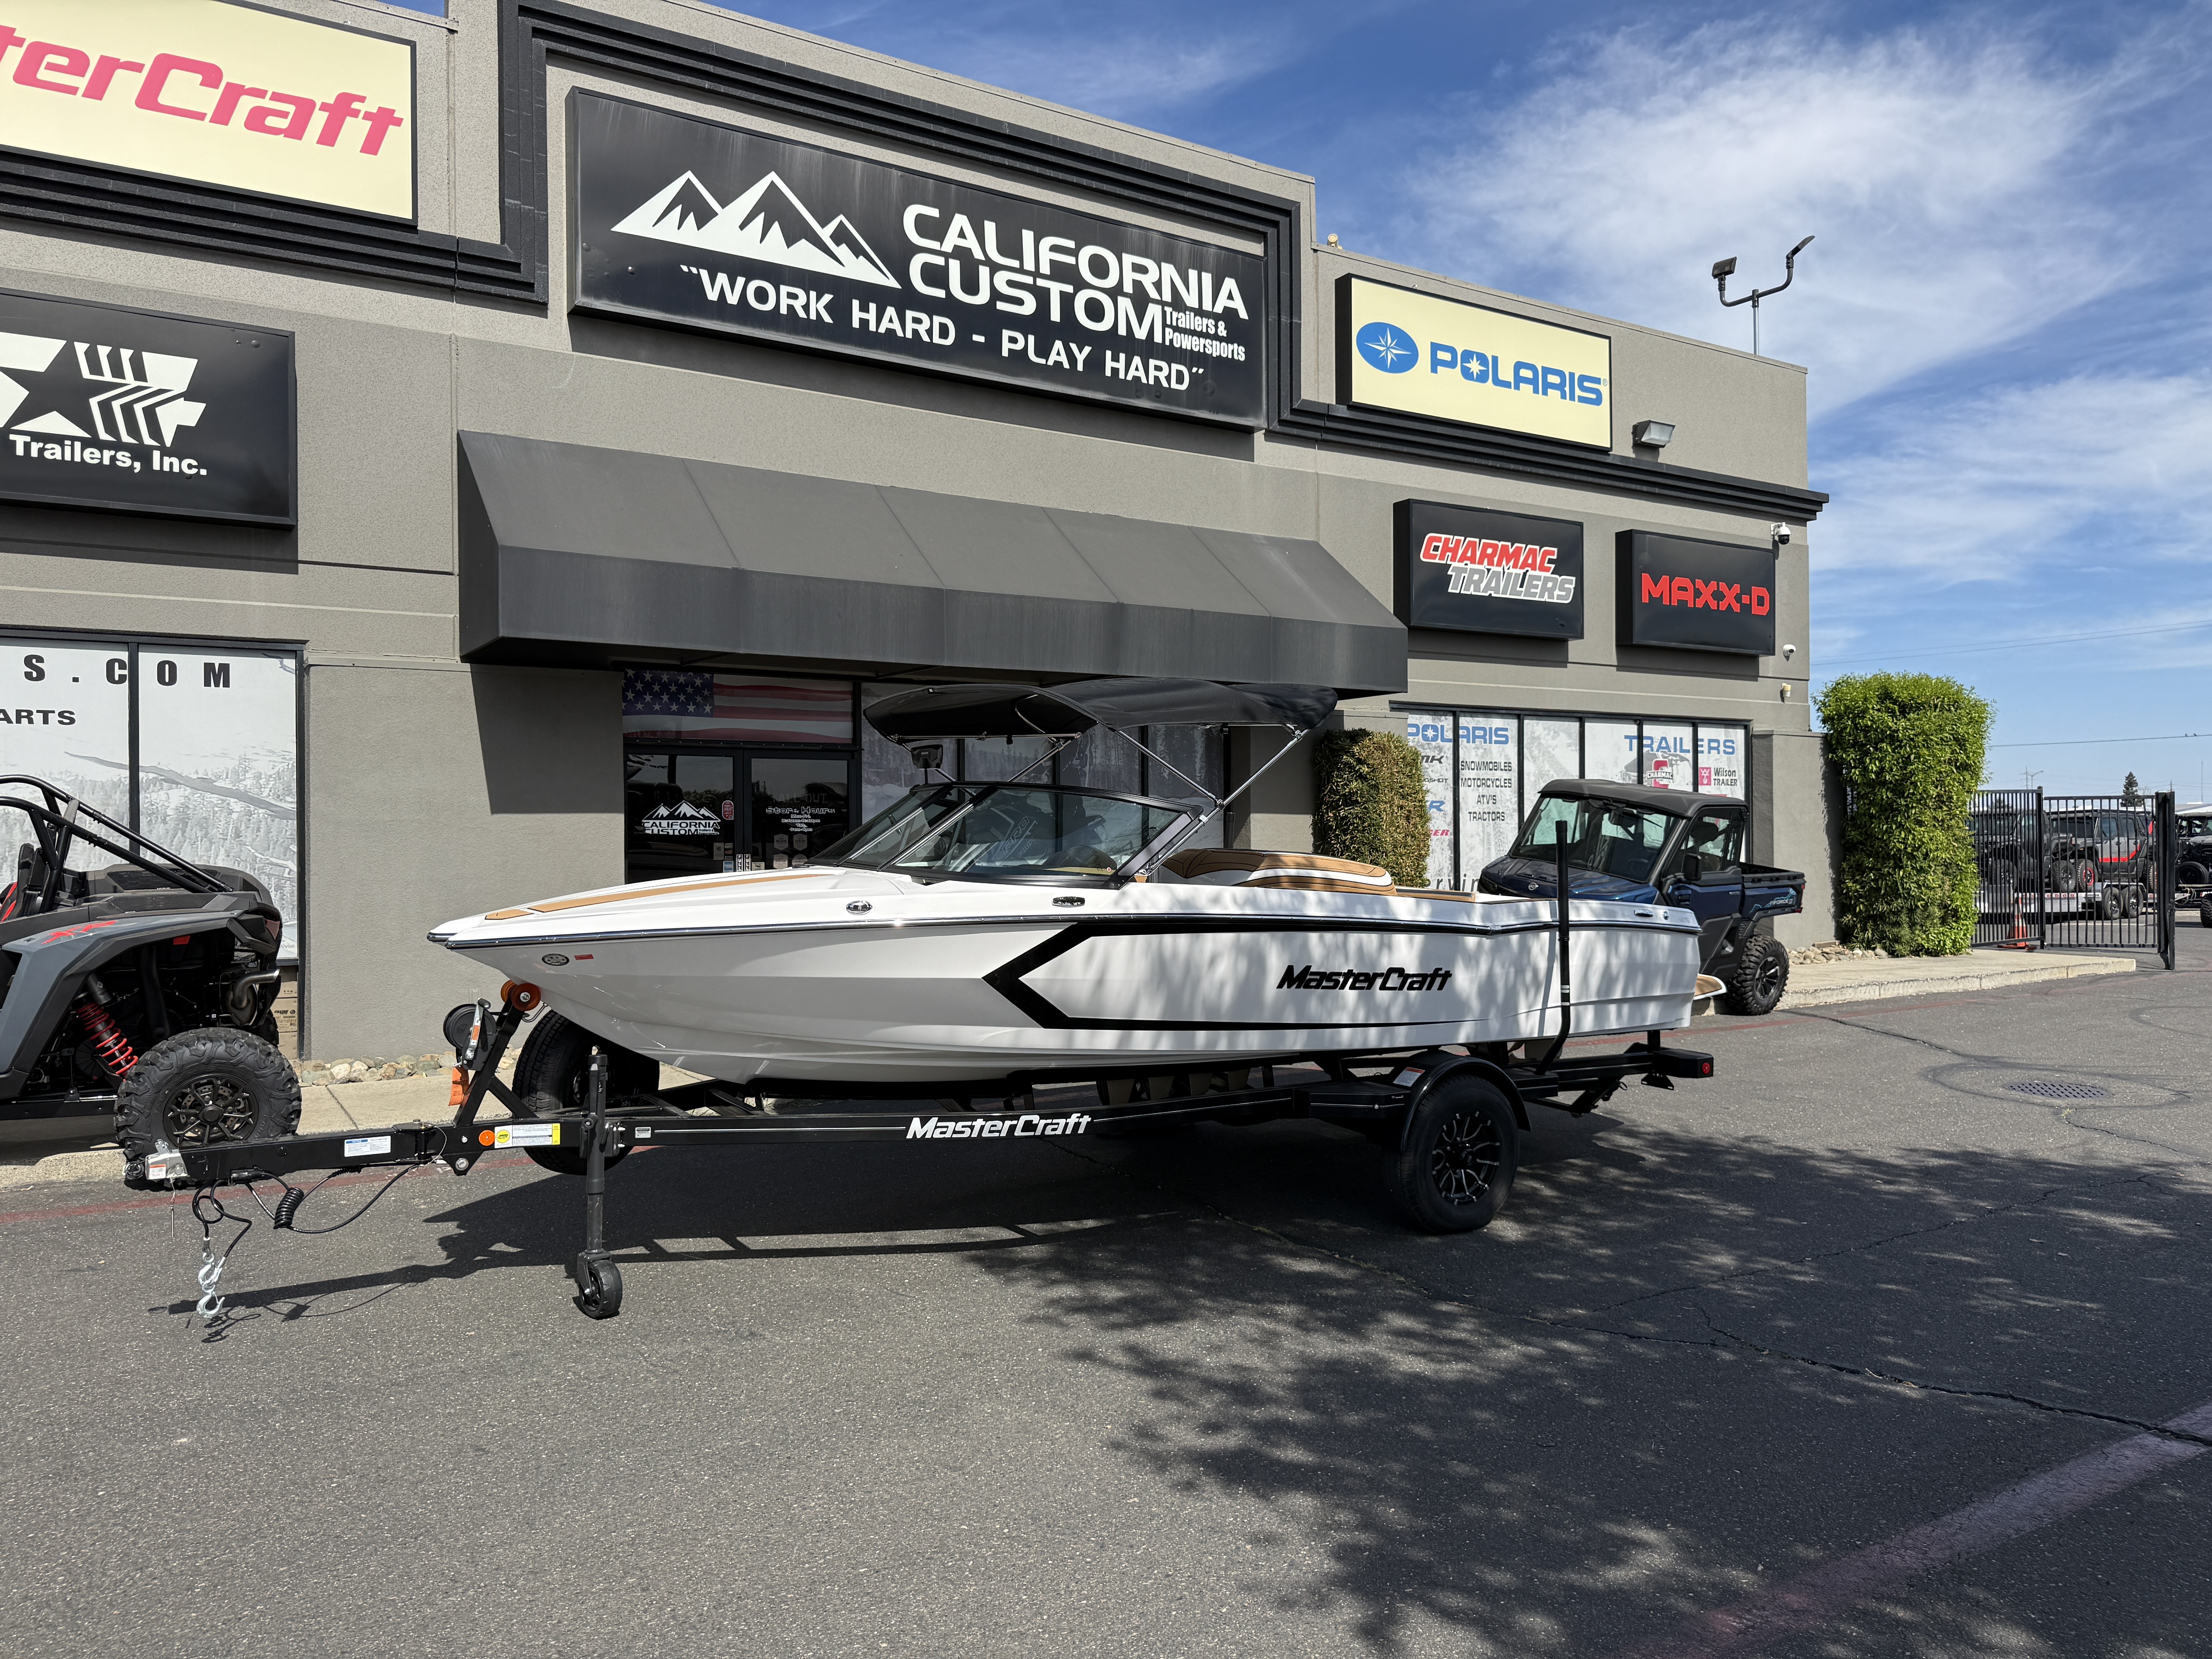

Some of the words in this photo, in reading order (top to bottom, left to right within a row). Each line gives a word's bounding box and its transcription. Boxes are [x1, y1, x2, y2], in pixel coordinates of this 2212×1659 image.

[903, 204, 1249, 319] CALIFORNIA
[909, 253, 1162, 343] CUSTOM
[852, 299, 955, 345] HARD
[1002, 329, 1092, 372] PLAY
[1164, 306, 1215, 334] Trailers
[1218, 321, 1227, 337] &
[1165, 327, 1245, 361] Powersports
[1430, 342, 1603, 406] POLARIS
[9, 434, 141, 473] Trailers,
[153, 450, 207, 476] Inc.
[1420, 533, 1557, 573] CHARMAC
[1448, 565, 1575, 603] TRAILERS
[1641, 573, 1770, 615] MAXX-D
[1408, 723, 1509, 745] POLARIS
[1624, 735, 1735, 755] TRAILERS
[1460, 761, 1512, 771] SNOWMOBILES
[1714, 767, 1736, 777] Wilson
[1460, 778, 1512, 788] MOTORCYCLES
[1477, 795, 1497, 805] ATV'S
[1468, 811, 1505, 822] TRACTORS
[1002, 816, 1030, 855] PRO
[1427, 873, 1479, 892] rvin
[1276, 965, 1452, 991] MasterCraft
[906, 1113, 1091, 1139] MasterCraft
